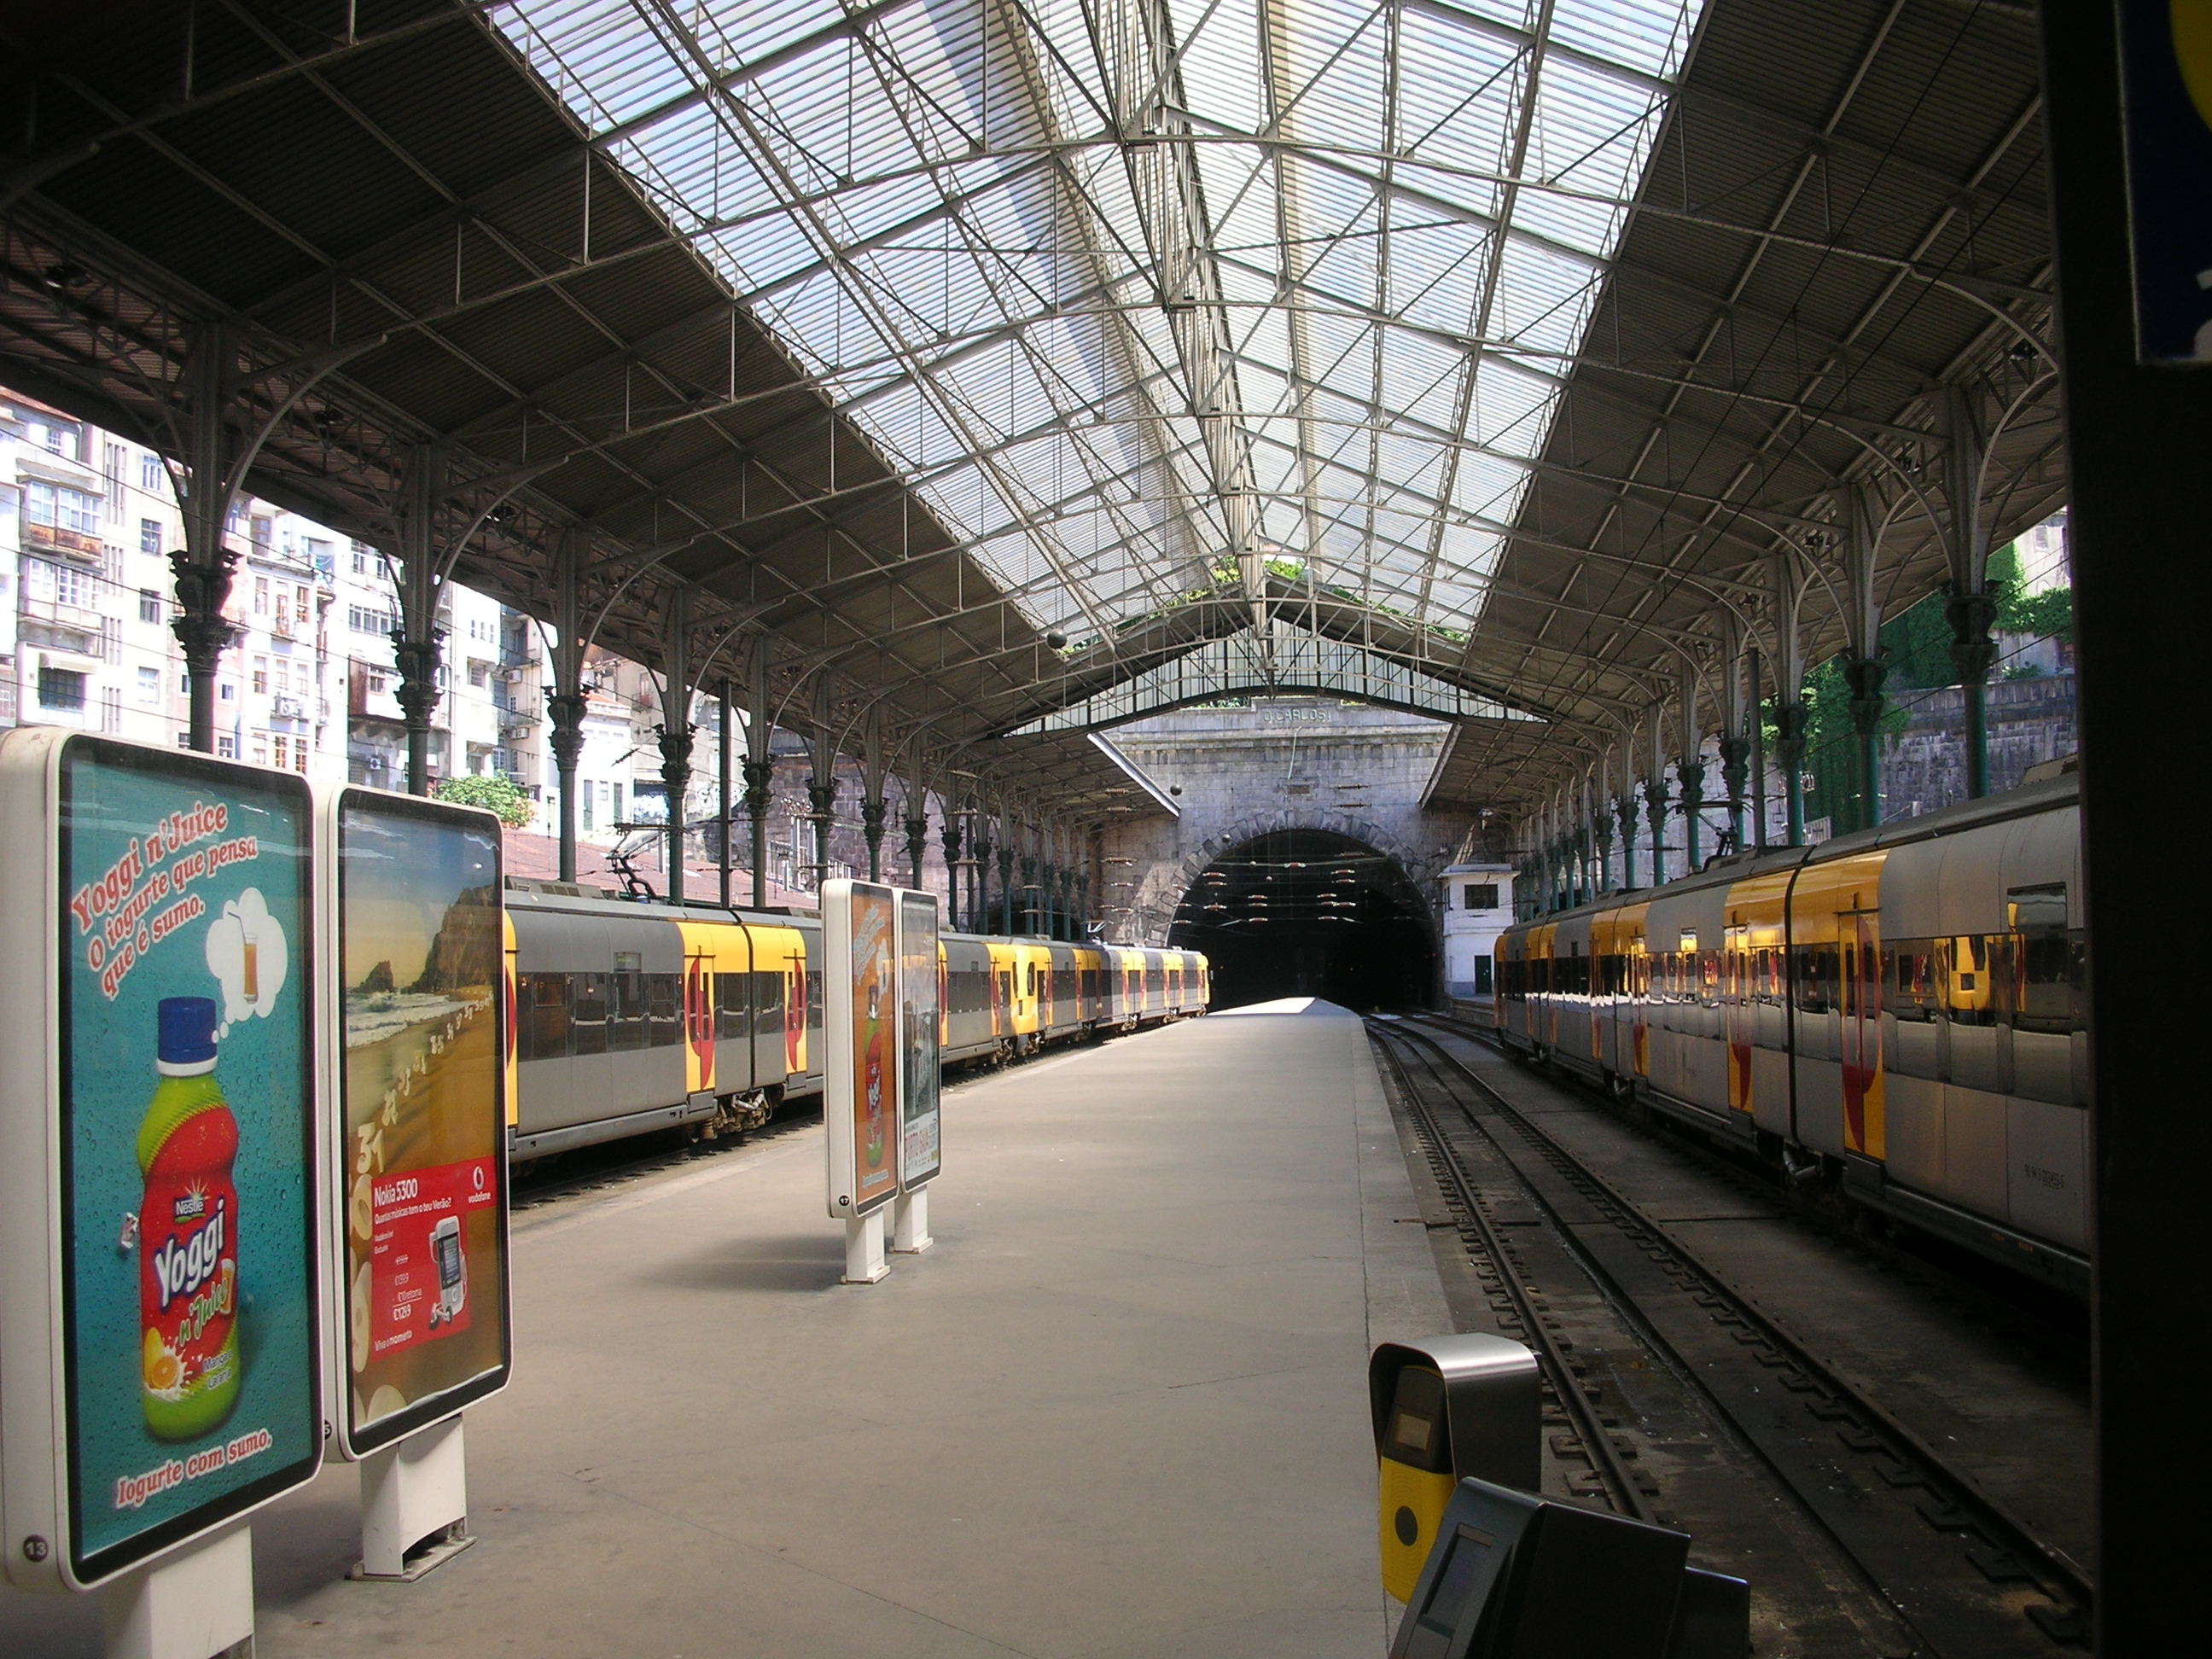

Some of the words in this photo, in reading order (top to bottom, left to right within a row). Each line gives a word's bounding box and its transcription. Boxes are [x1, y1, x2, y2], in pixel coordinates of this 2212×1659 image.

[72, 840, 142, 931] Yoggi
[146, 802, 228, 865] n'Juice
[89, 937, 104, 969] O
[106, 873, 169, 946] iogurte
[173, 852, 204, 892] que
[207, 837, 258, 876] pensa
[102, 943, 134, 998] que
[138, 921, 148, 952] é
[152, 895, 205, 940] sumo.
[374, 1184, 395, 1207] Nokia
[396, 1179, 418, 1201] 5300
[468, 1191, 492, 1203] vodafone
[154, 1198, 224, 1308] Yoggi
[117, 1460, 183, 1507] Iogurte
[186, 1448, 224, 1477] com
[227, 1429, 272, 1463] sumo.
[26, 1541, 48, 1557] 13
